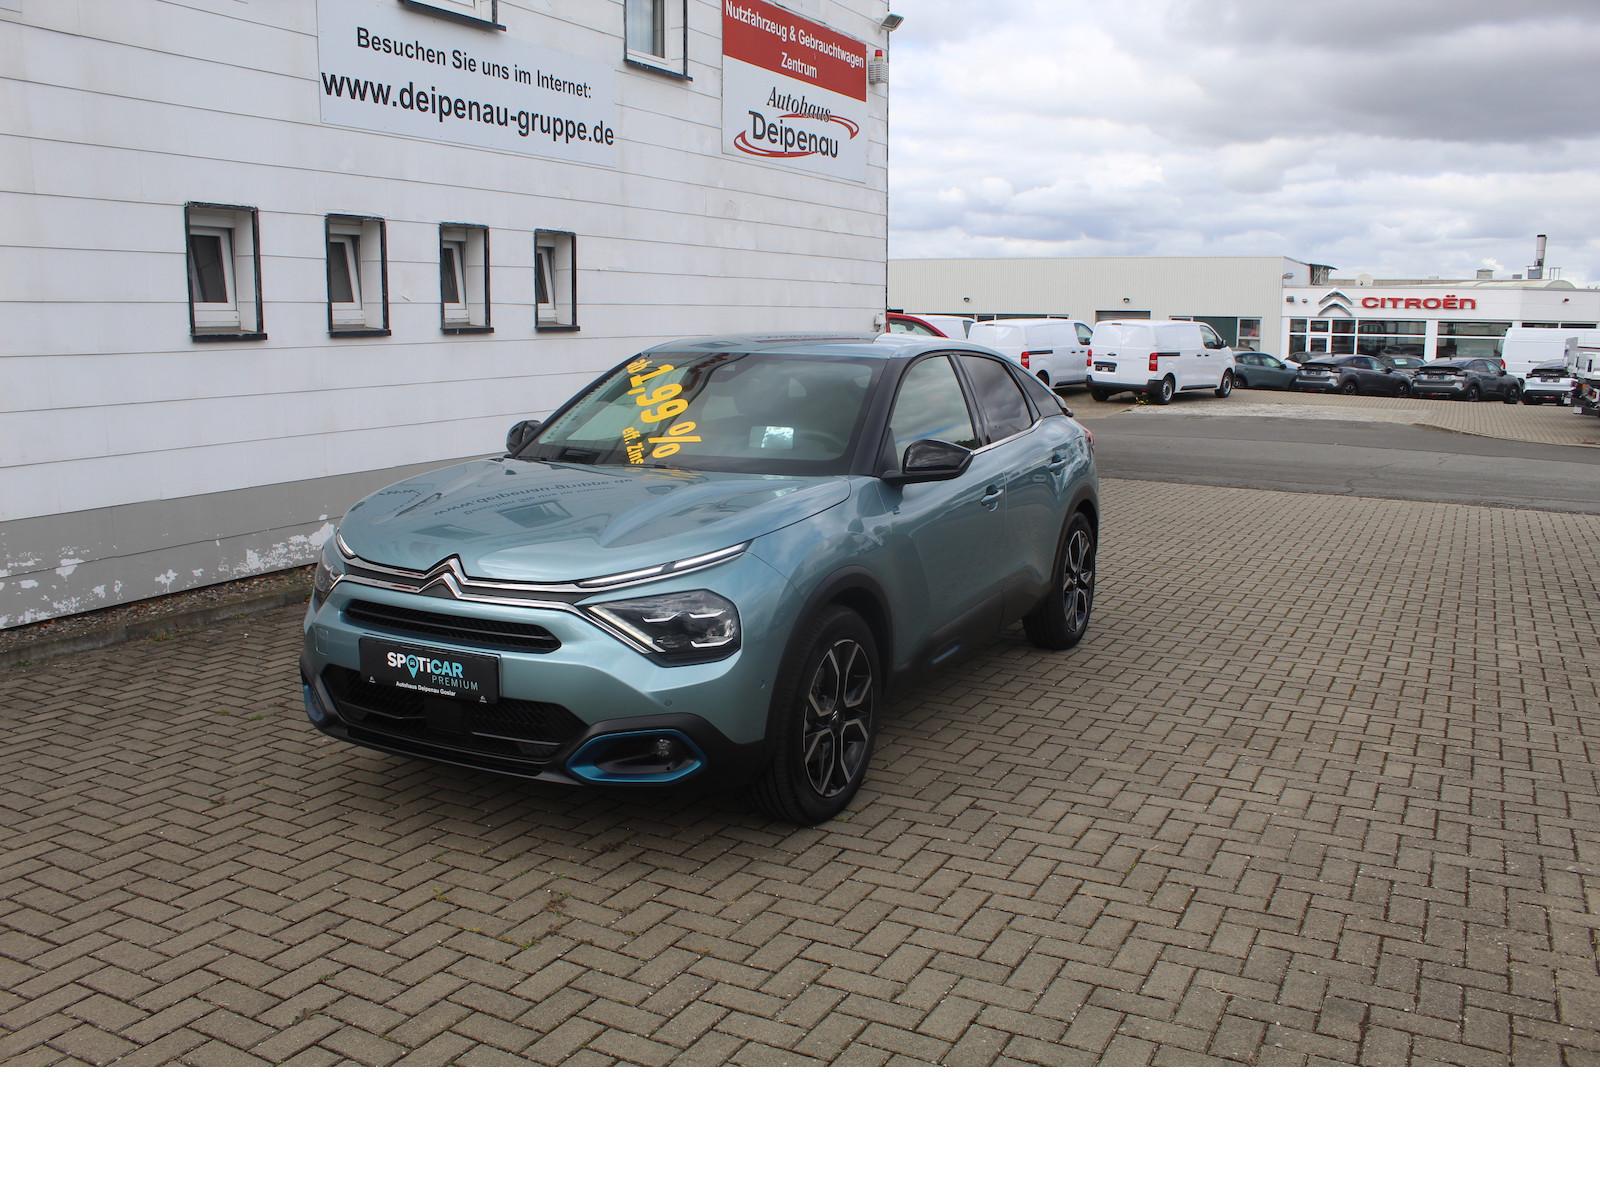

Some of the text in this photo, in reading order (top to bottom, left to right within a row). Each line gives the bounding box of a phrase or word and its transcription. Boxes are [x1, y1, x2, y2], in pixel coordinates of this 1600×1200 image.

[725, 0, 865, 69] Nutzfahrzeug & Gebrauchtwagen
[356, 26, 593, 99] Besuchen Sie uns im Internet:
[781, 52, 818, 79] Zentrum
[321, 71, 615, 146] www.deipenau-gruppe.de
[766, 86, 831, 123] Autohaus
[748, 110, 839, 158] Deipenau
[626, 357, 702, 458] ab 1,99 %
[626, 442, 645, 465] Zins
[395, 680, 457, 697] Autohaus Deipenau Goslar
[431, 674, 479, 691] PREMIUM
